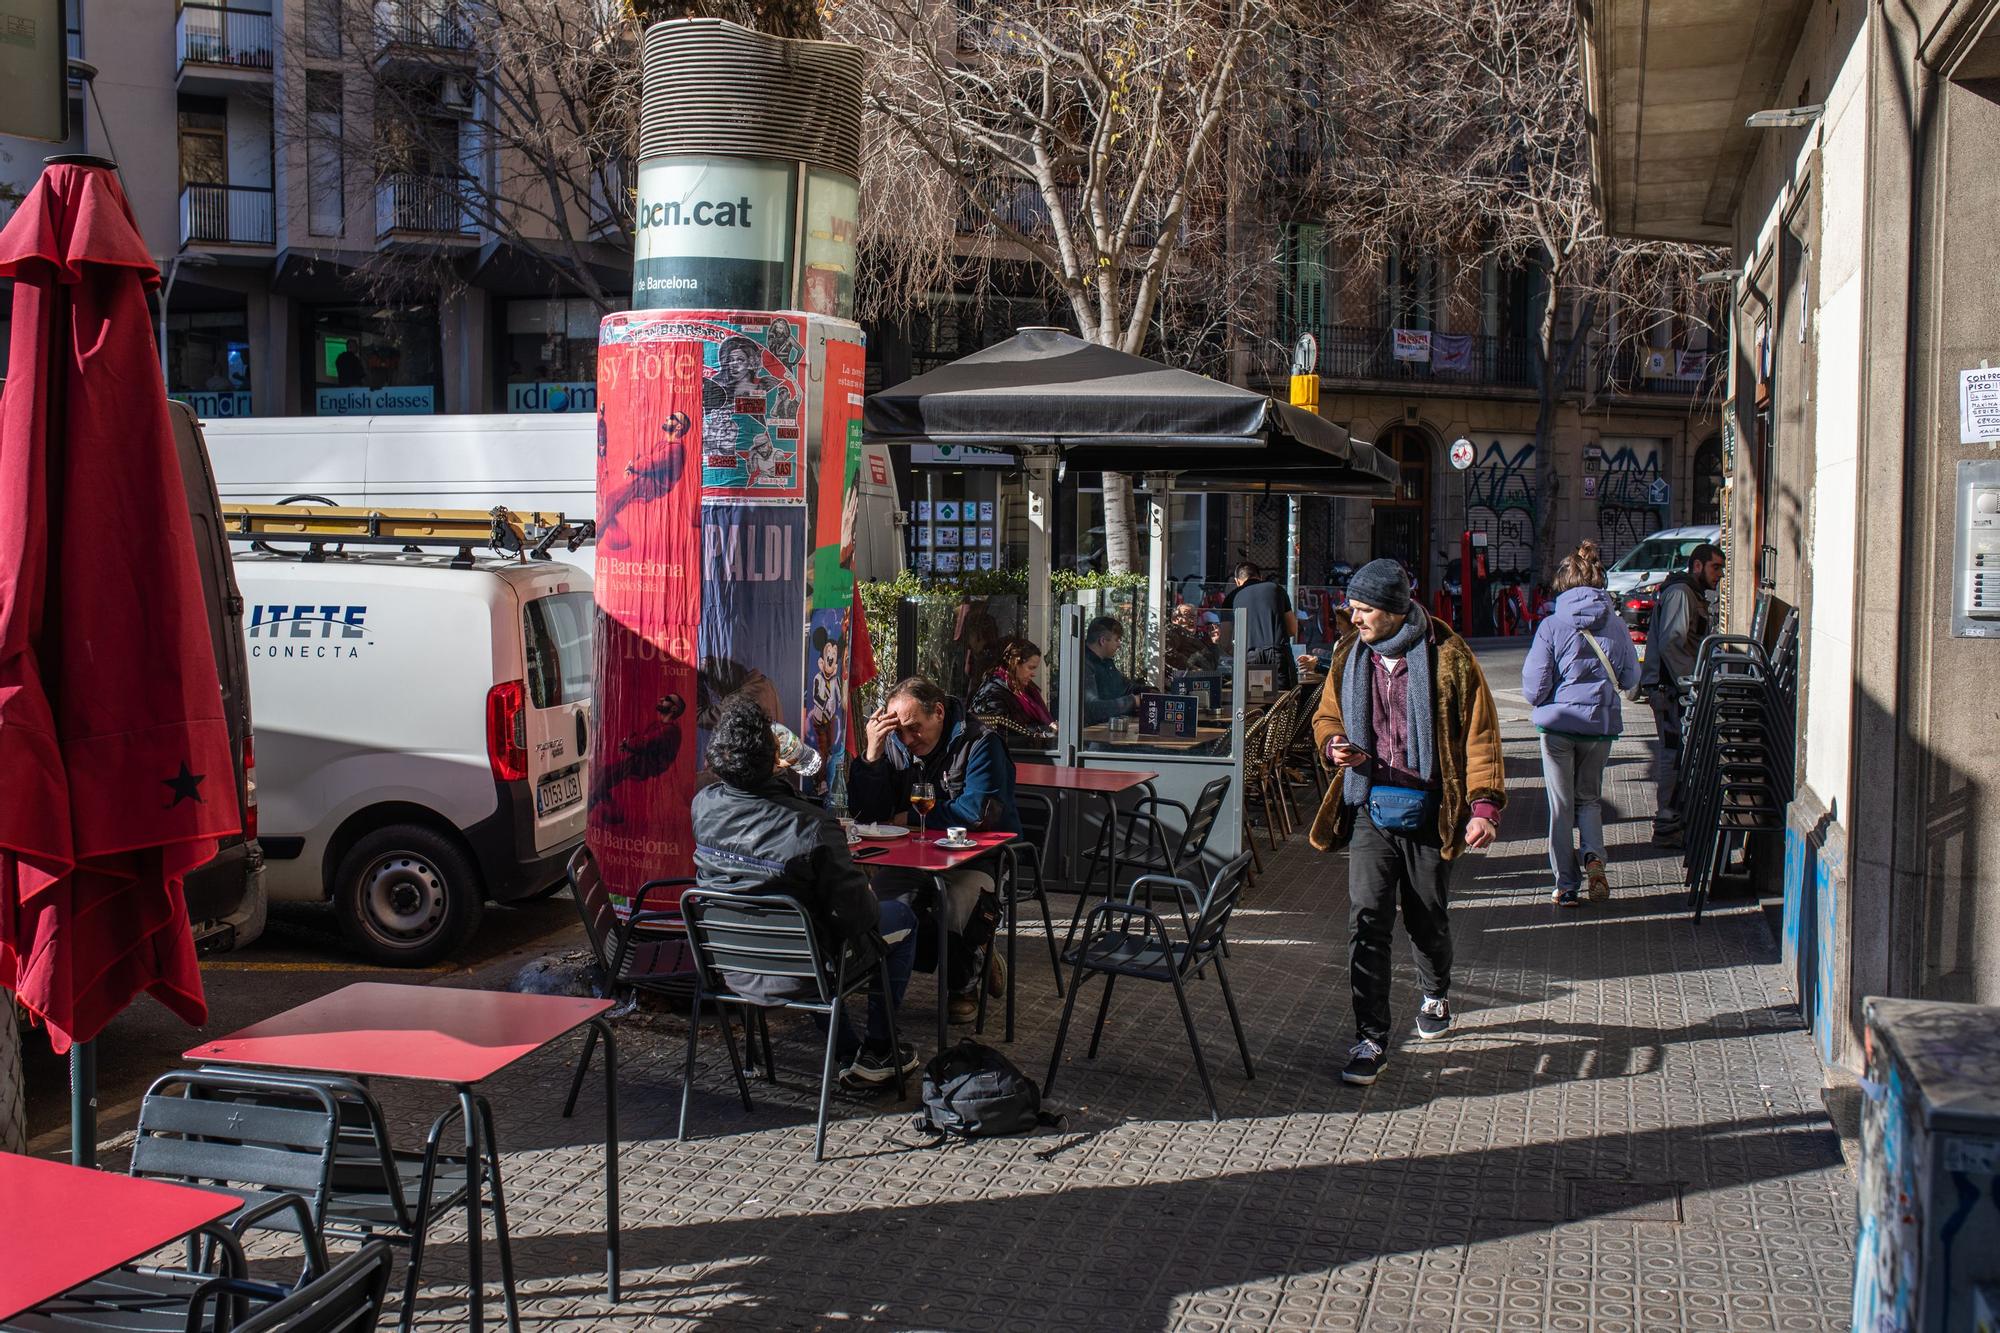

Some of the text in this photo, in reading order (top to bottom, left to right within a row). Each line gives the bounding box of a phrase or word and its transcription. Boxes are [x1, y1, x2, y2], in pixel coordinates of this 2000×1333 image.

[640, 197, 753, 229] bcn.cat
[647, 276, 698, 290] Barcelona
[625, 347, 695, 381] Tote
[669, 384, 695, 394] Tour
[320, 393, 429, 413] English classes
[610, 558, 684, 578] Barcelona
[249, 605, 367, 638] ITETE
[252, 646, 358, 658] CONECTA
[619, 627, 691, 662] Tote
[542, 777, 578, 807] 0153 LCB
[604, 830, 680, 856] Barcelona
[714, 851, 744, 861] NIKE
